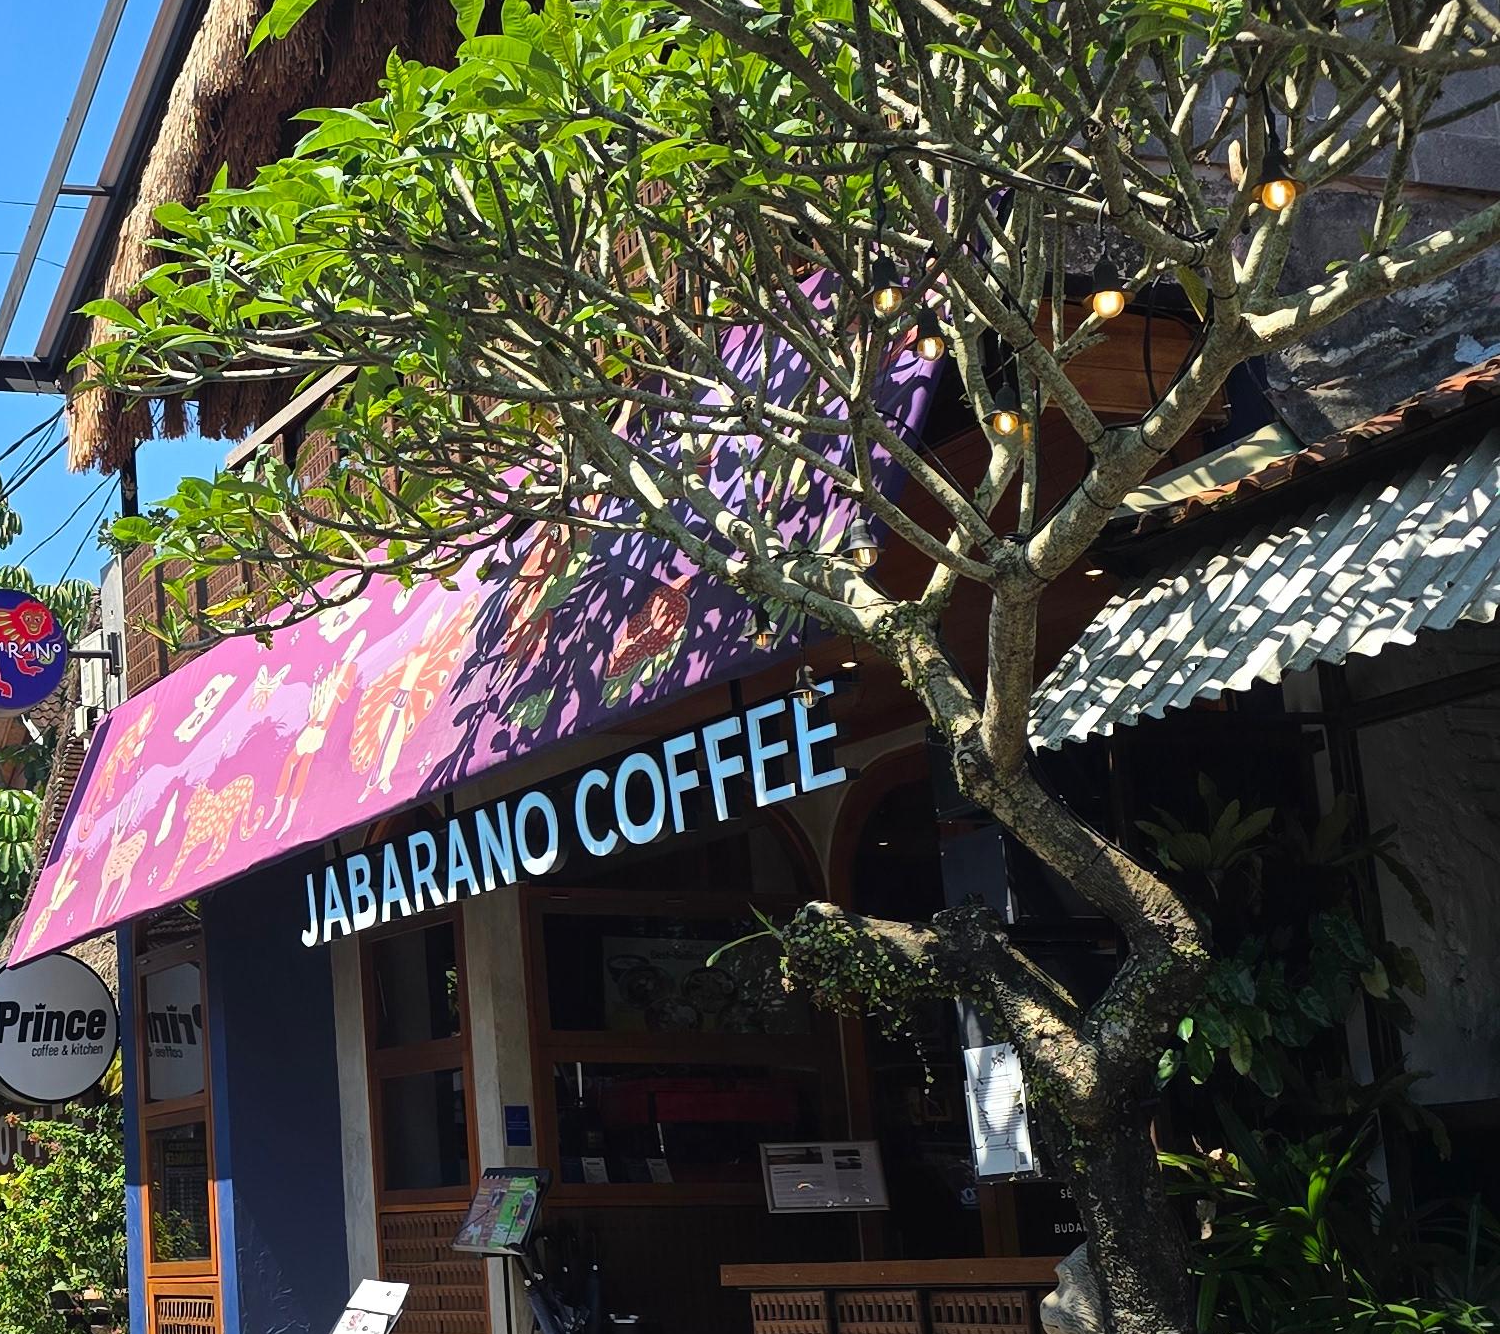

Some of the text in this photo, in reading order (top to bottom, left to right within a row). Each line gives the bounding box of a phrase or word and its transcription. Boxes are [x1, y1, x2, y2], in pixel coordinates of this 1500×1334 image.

[301, 680, 848, 949] JABARANO COFFEE
[31, 1044, 103, 1057] coffee & kitchen
